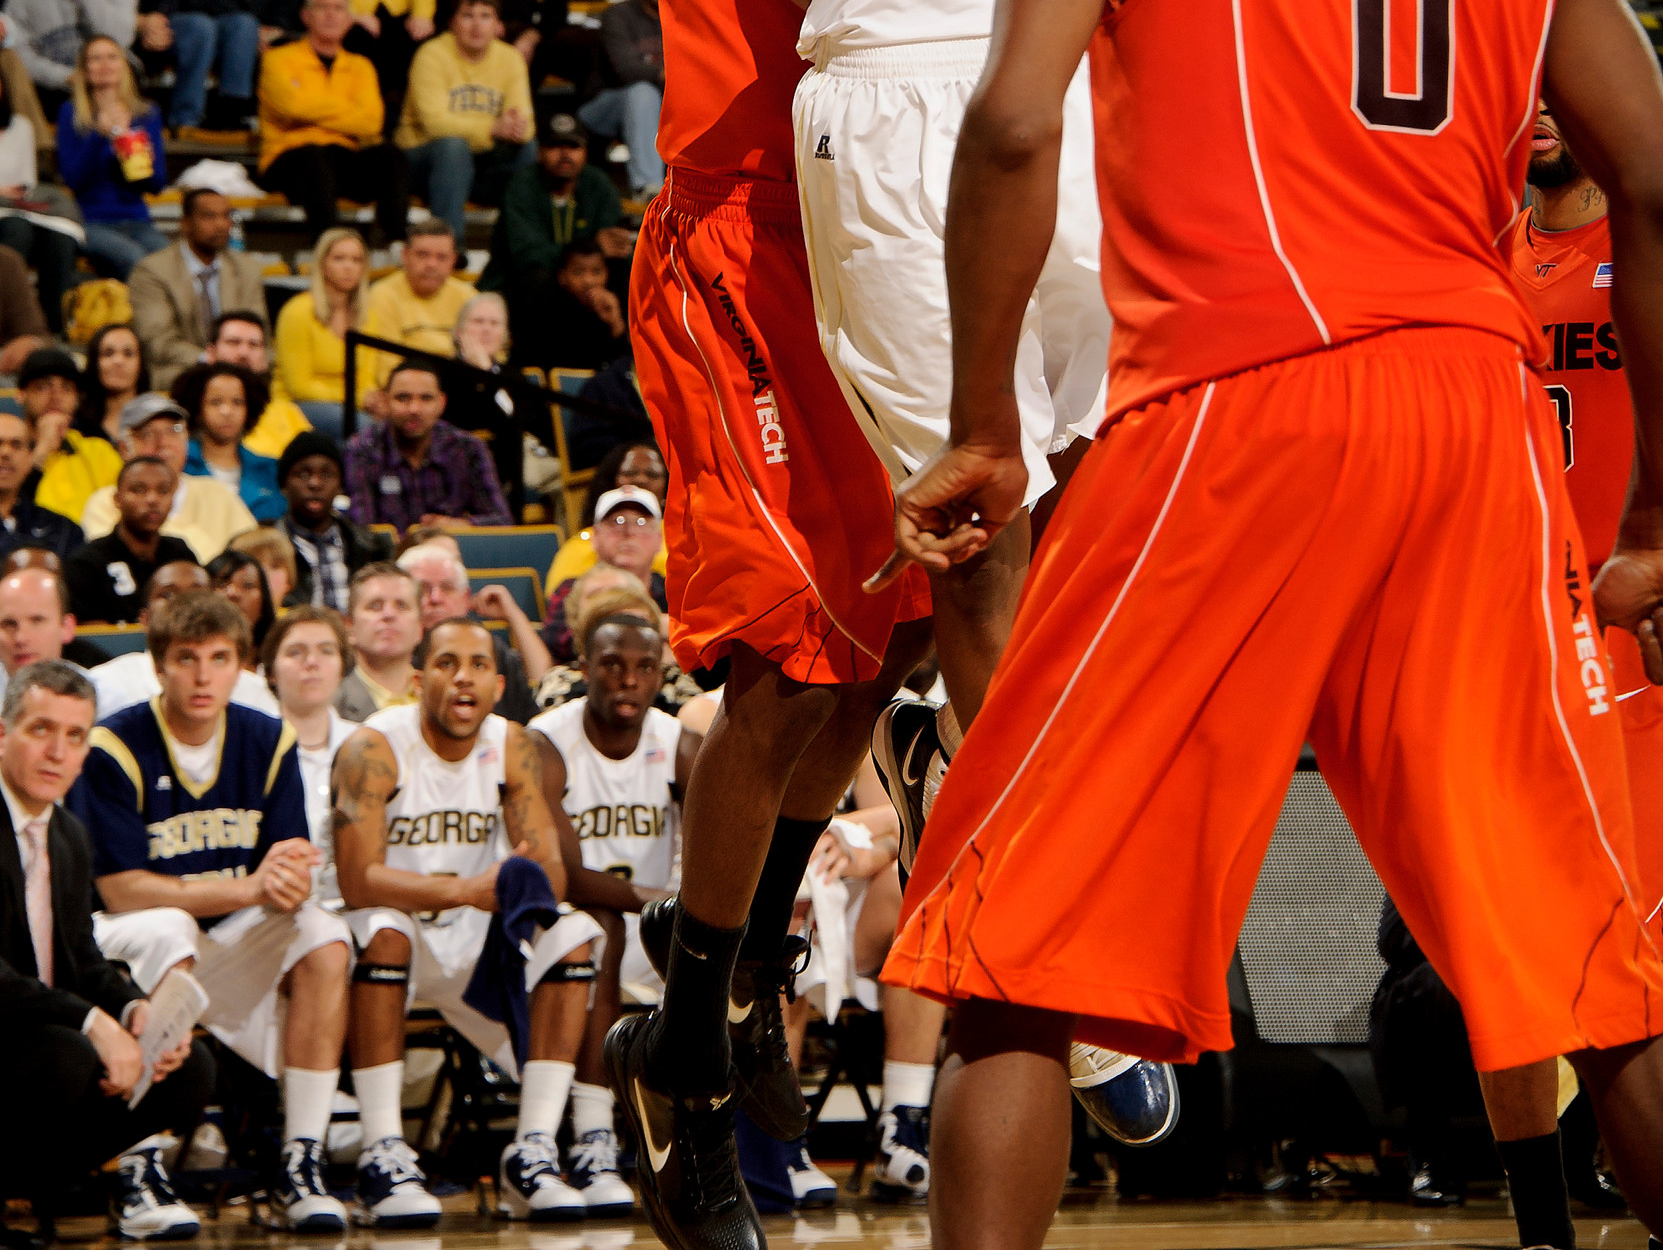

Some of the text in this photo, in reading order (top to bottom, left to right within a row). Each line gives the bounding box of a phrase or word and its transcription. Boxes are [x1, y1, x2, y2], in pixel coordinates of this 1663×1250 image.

[710, 271, 789, 465] VIRGINIA TECH
[106, 561, 136, 596] 3
[1572, 613, 1610, 717] TECH
